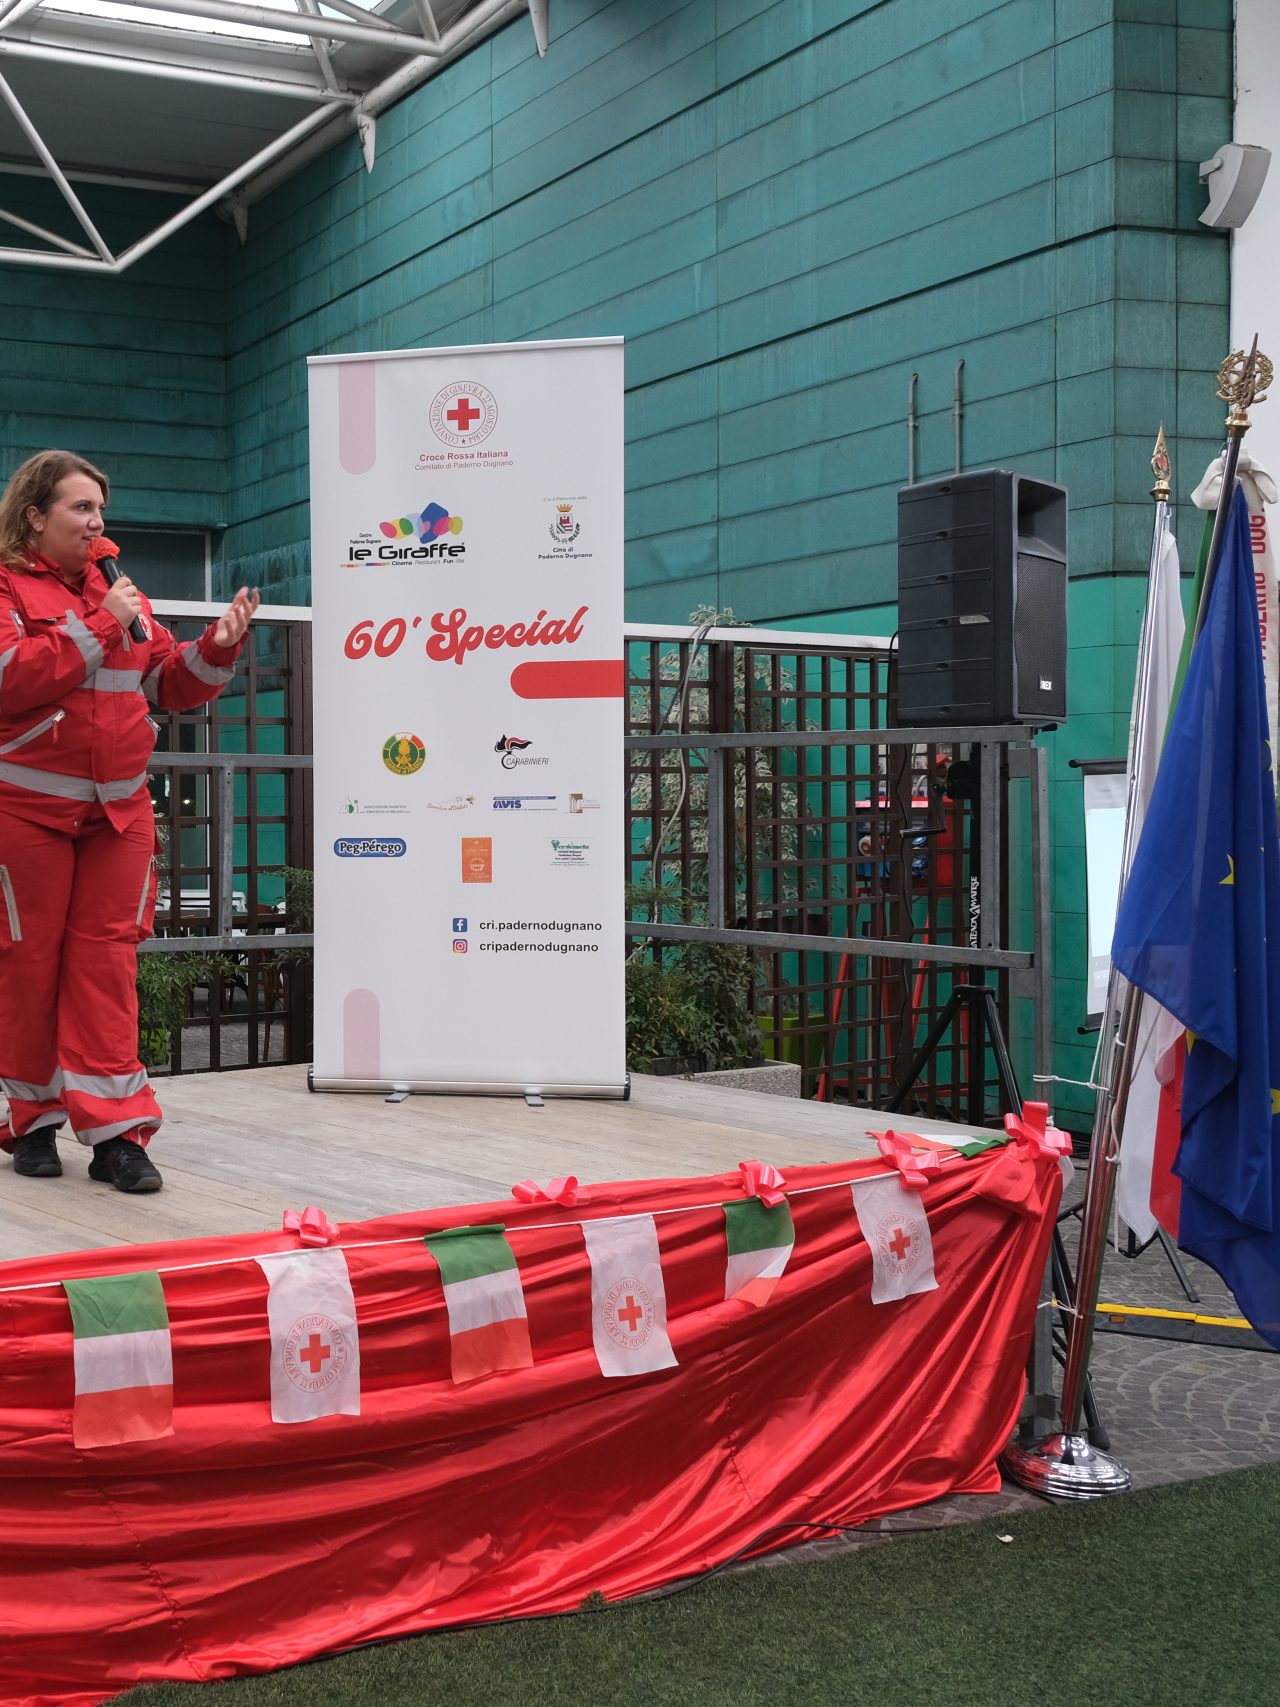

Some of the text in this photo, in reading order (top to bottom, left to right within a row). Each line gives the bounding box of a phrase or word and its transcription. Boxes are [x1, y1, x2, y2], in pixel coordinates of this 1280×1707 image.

[440, 391, 450, 400] DI
[449, 384, 484, 396] GINEVRA
[432, 400, 459, 444] CONVENZIONE
[482, 404, 495, 434] AGOSTO
[420, 450, 508, 462] Croce Rossa Italiana
[349, 547, 371, 561] le
[425, 605, 589, 665] Special
[506, 757, 549, 765] CARABINIERI
[493, 800, 521, 809] AVIS
[479, 920, 602, 933] cri.padernodugnano
[479, 941, 599, 954] cripadernodugnano
